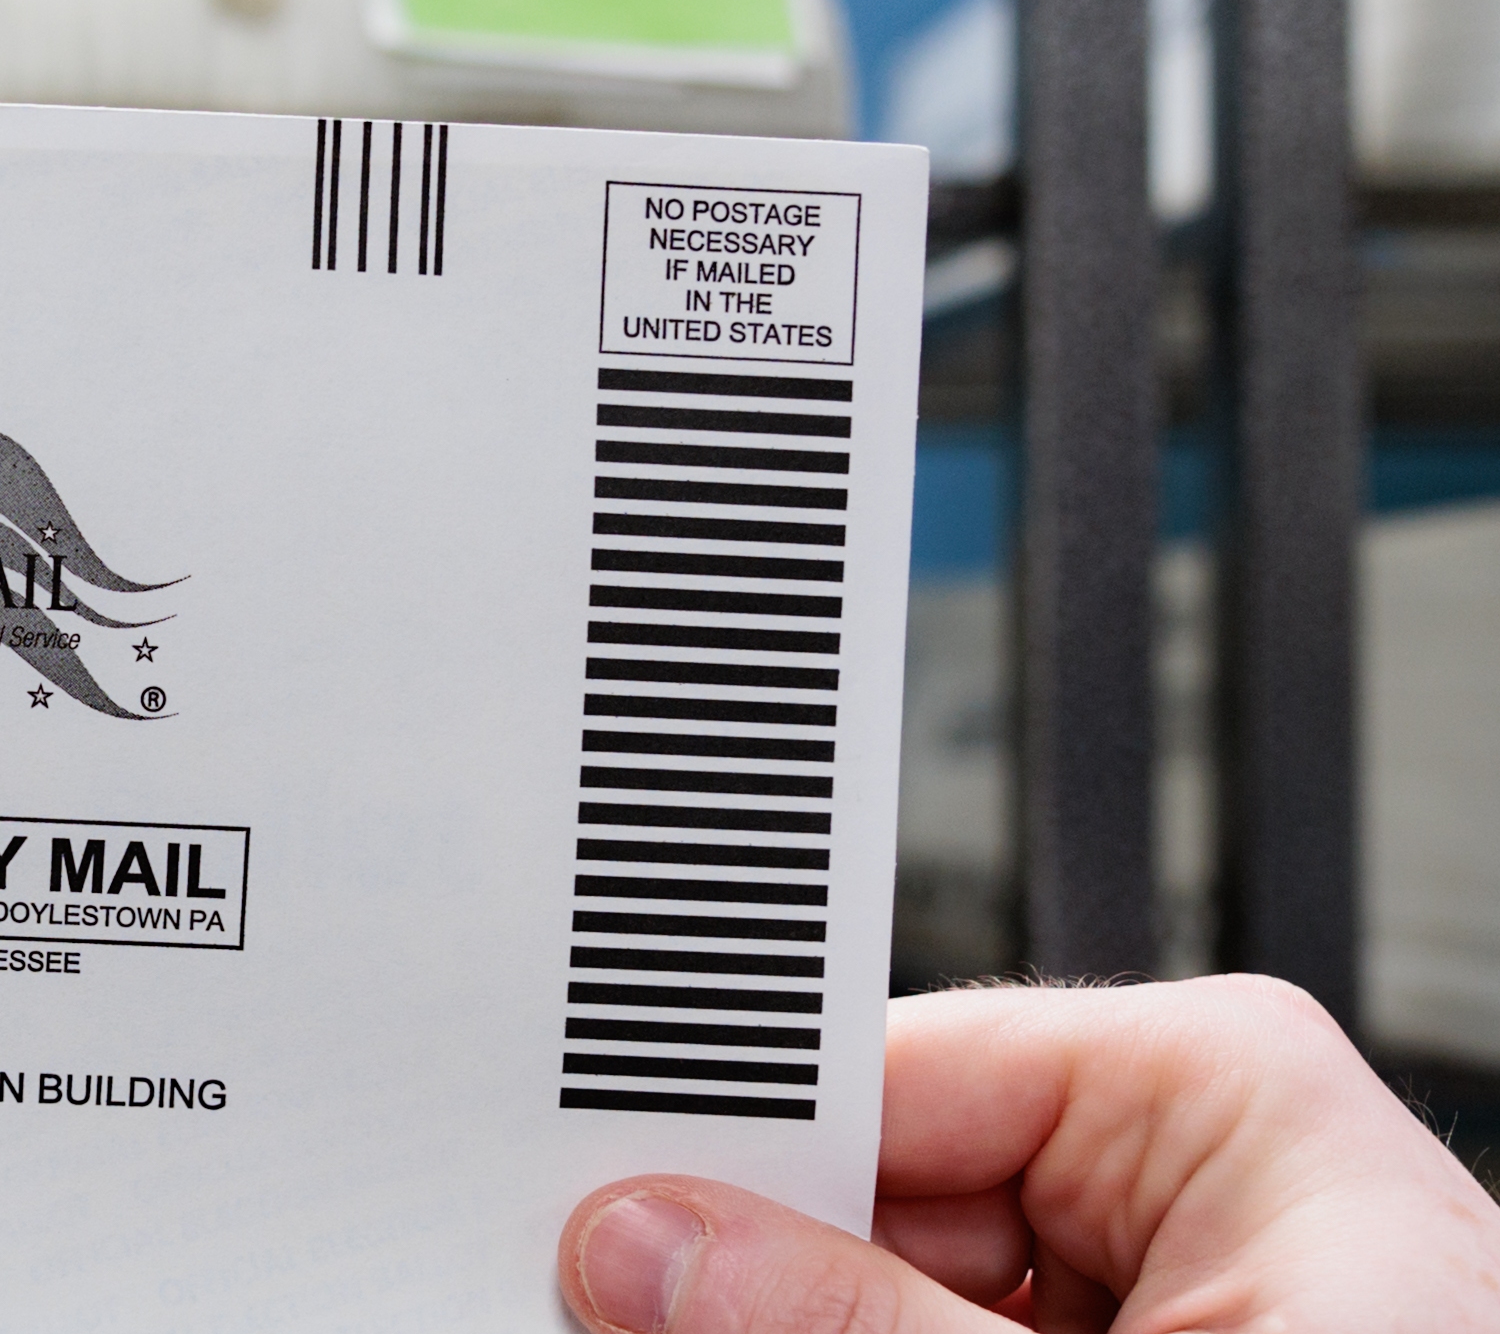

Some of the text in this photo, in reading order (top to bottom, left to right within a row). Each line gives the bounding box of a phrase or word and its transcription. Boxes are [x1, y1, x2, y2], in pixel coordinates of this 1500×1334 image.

[645, 197, 821, 228] NO POSTAGE
[649, 227, 816, 257] NECESSARY
[665, 258, 796, 286] IF MAILED
[685, 289, 773, 315] IN THE
[623, 315, 833, 348] UNITED STATES
[9, 626, 82, 650] Service
[49, 837, 227, 900] MAIL
[189, 909, 225, 933] PA
[38, 1072, 227, 1111] BUILDING
